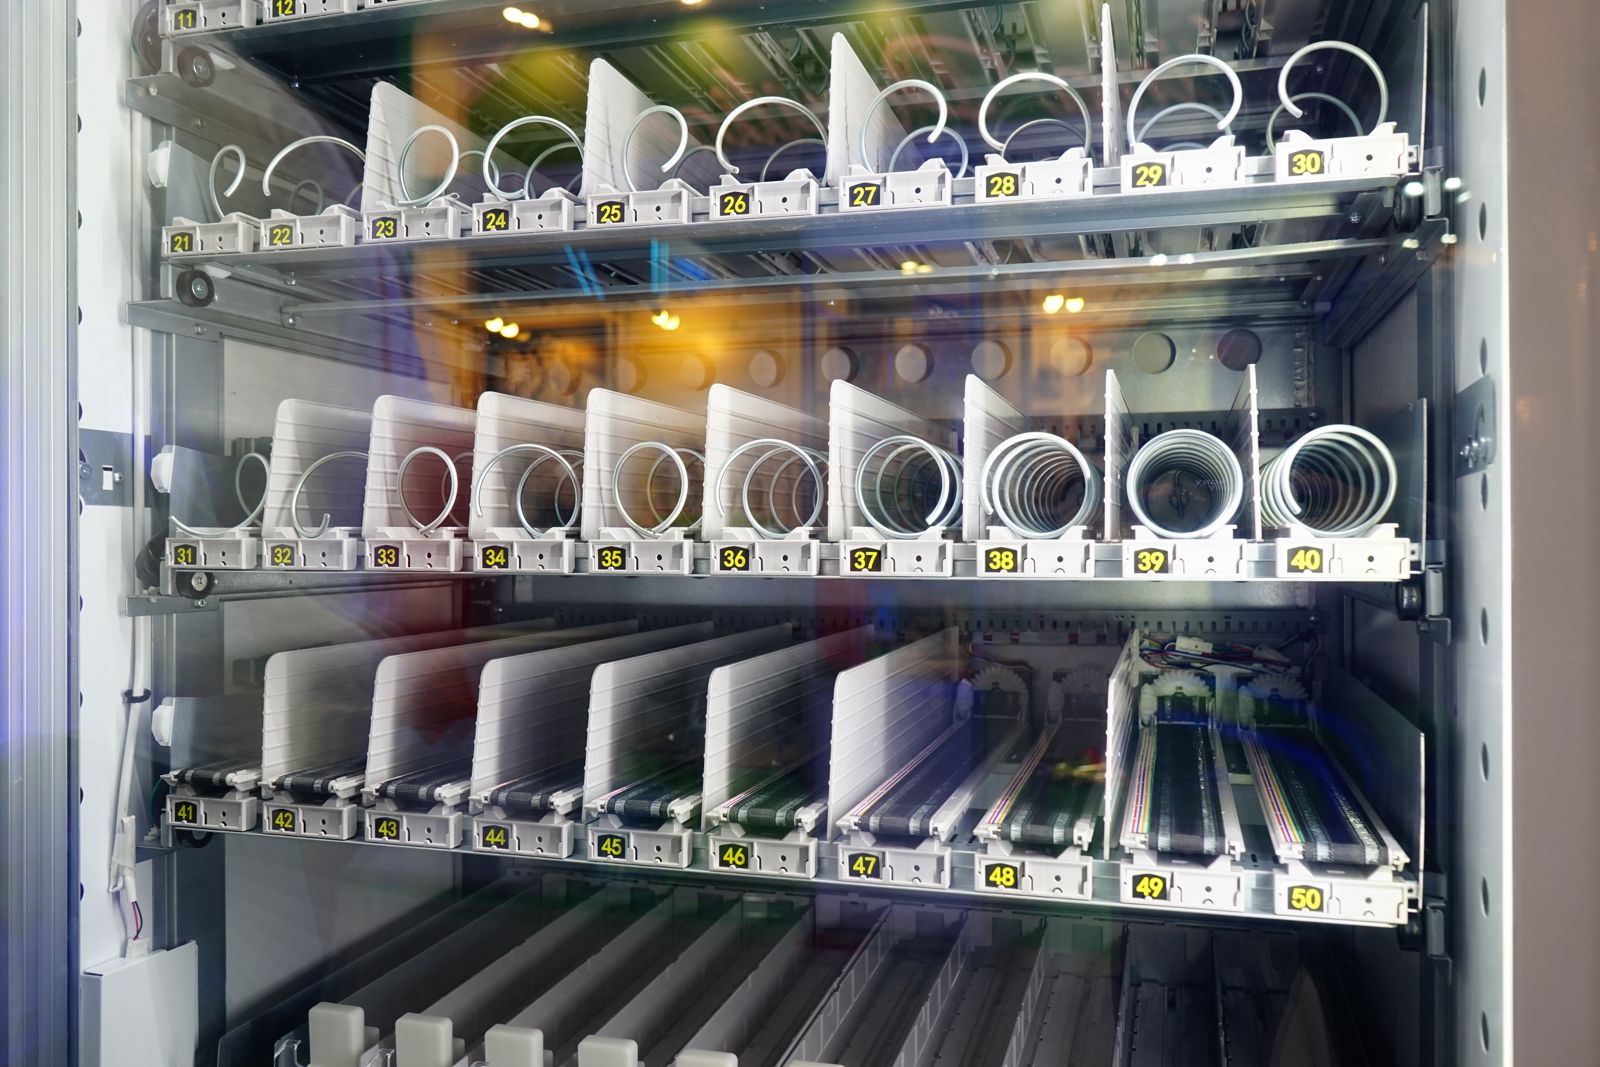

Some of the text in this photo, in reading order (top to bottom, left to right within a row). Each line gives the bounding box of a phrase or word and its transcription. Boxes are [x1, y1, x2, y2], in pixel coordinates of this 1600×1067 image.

[276, 0, 293, 14] 12
[177, 12, 192, 27] 11
[1292, 152, 1321, 174] 30
[1136, 164, 1162, 186] 29
[991, 176, 1015, 195] 28
[854, 186, 876, 204] 27
[724, 195, 746, 214] 26
[486, 212, 506, 229] 24
[600, 205, 621, 222] 25
[272, 227, 291, 244] 22
[376, 220, 394, 236] 23
[174, 235, 191, 251] 21
[177, 547, 192, 562] 31
[274, 548, 291, 564] 32
[378, 548, 396, 564] 33
[486, 549, 505, 565] 34
[601, 550, 622, 567] 35
[724, 550, 746, 567] 36
[854, 551, 877, 569] 37
[989, 550, 1014, 570] 38
[1138, 551, 1165, 571] 39
[1290, 549, 1321, 570] 40
[178, 805, 192, 820] 41
[275, 812, 293, 828] 42
[378, 821, 396, 836] 43
[486, 829, 505, 844] 44
[601, 838, 622, 855] 45
[723, 847, 745, 865] 46
[853, 856, 876, 874] 47
[989, 866, 1015, 886] 48
[1136, 876, 1164, 897] 49
[1292, 888, 1321, 910] 50
